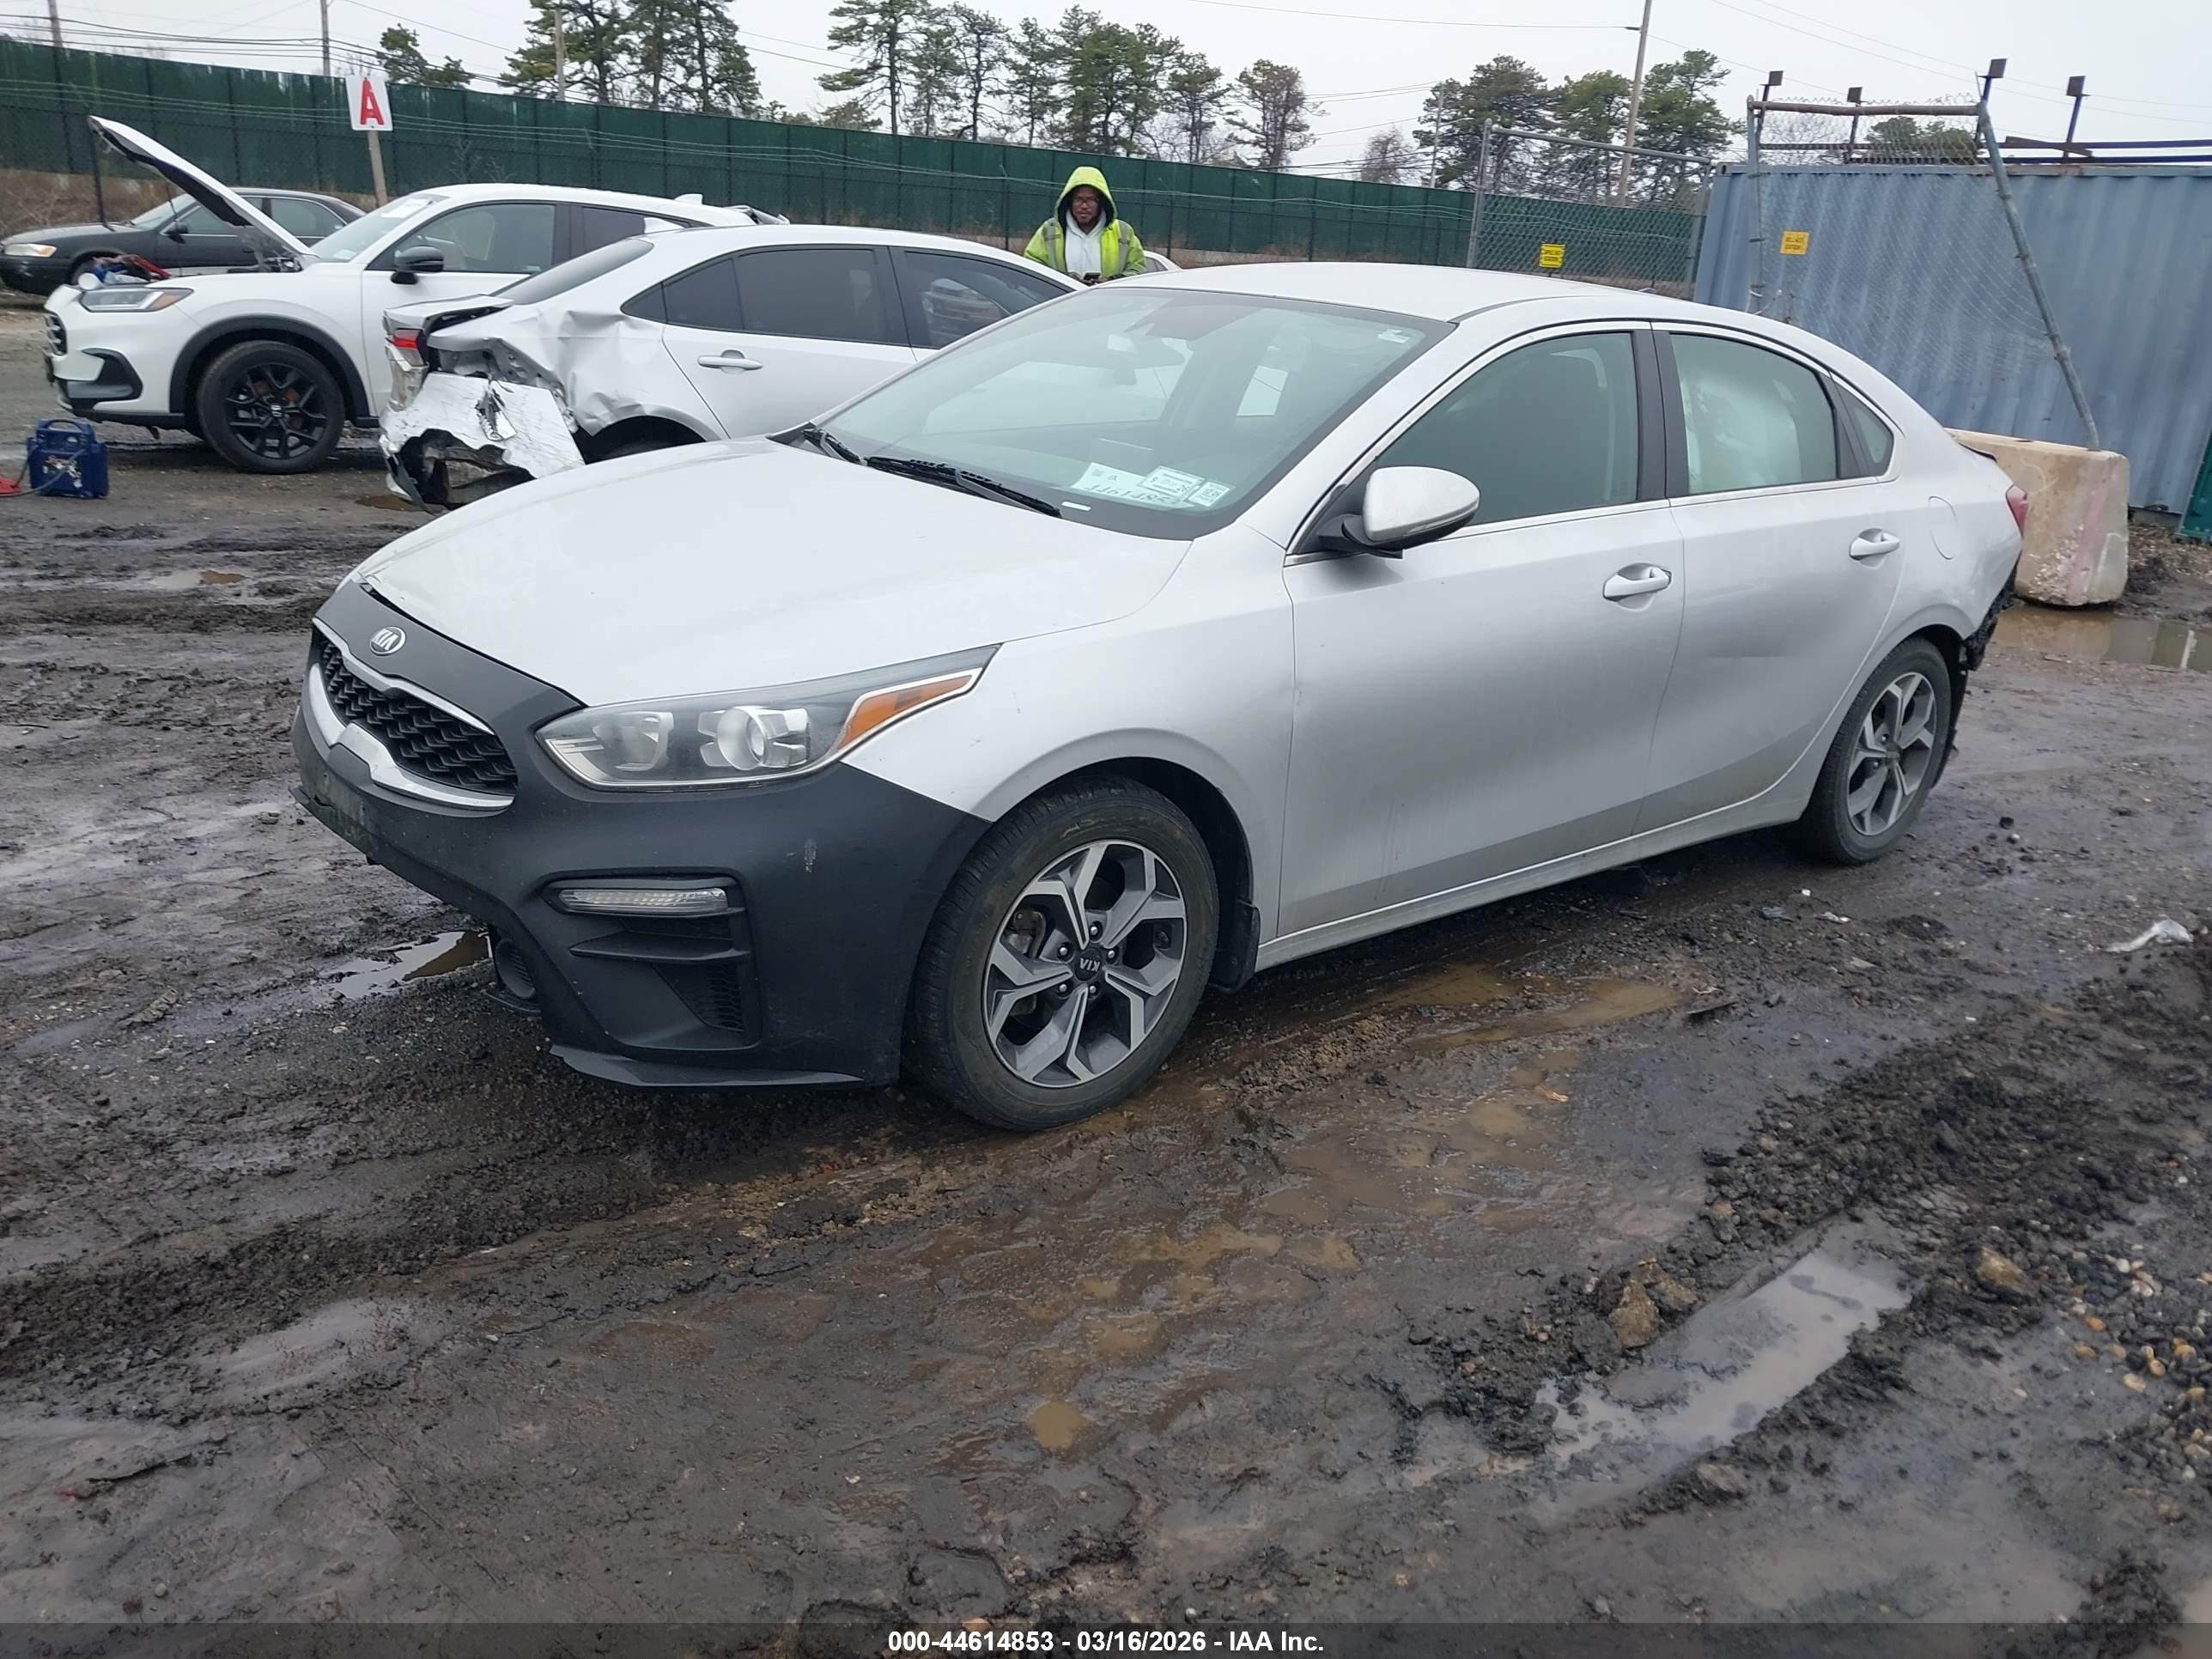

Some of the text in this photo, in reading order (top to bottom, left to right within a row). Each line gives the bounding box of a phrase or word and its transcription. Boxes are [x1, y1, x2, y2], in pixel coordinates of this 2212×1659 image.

[360, 79, 385, 125] A
[371, 628, 400, 651] KIA
[1079, 957, 1101, 972] KIA
